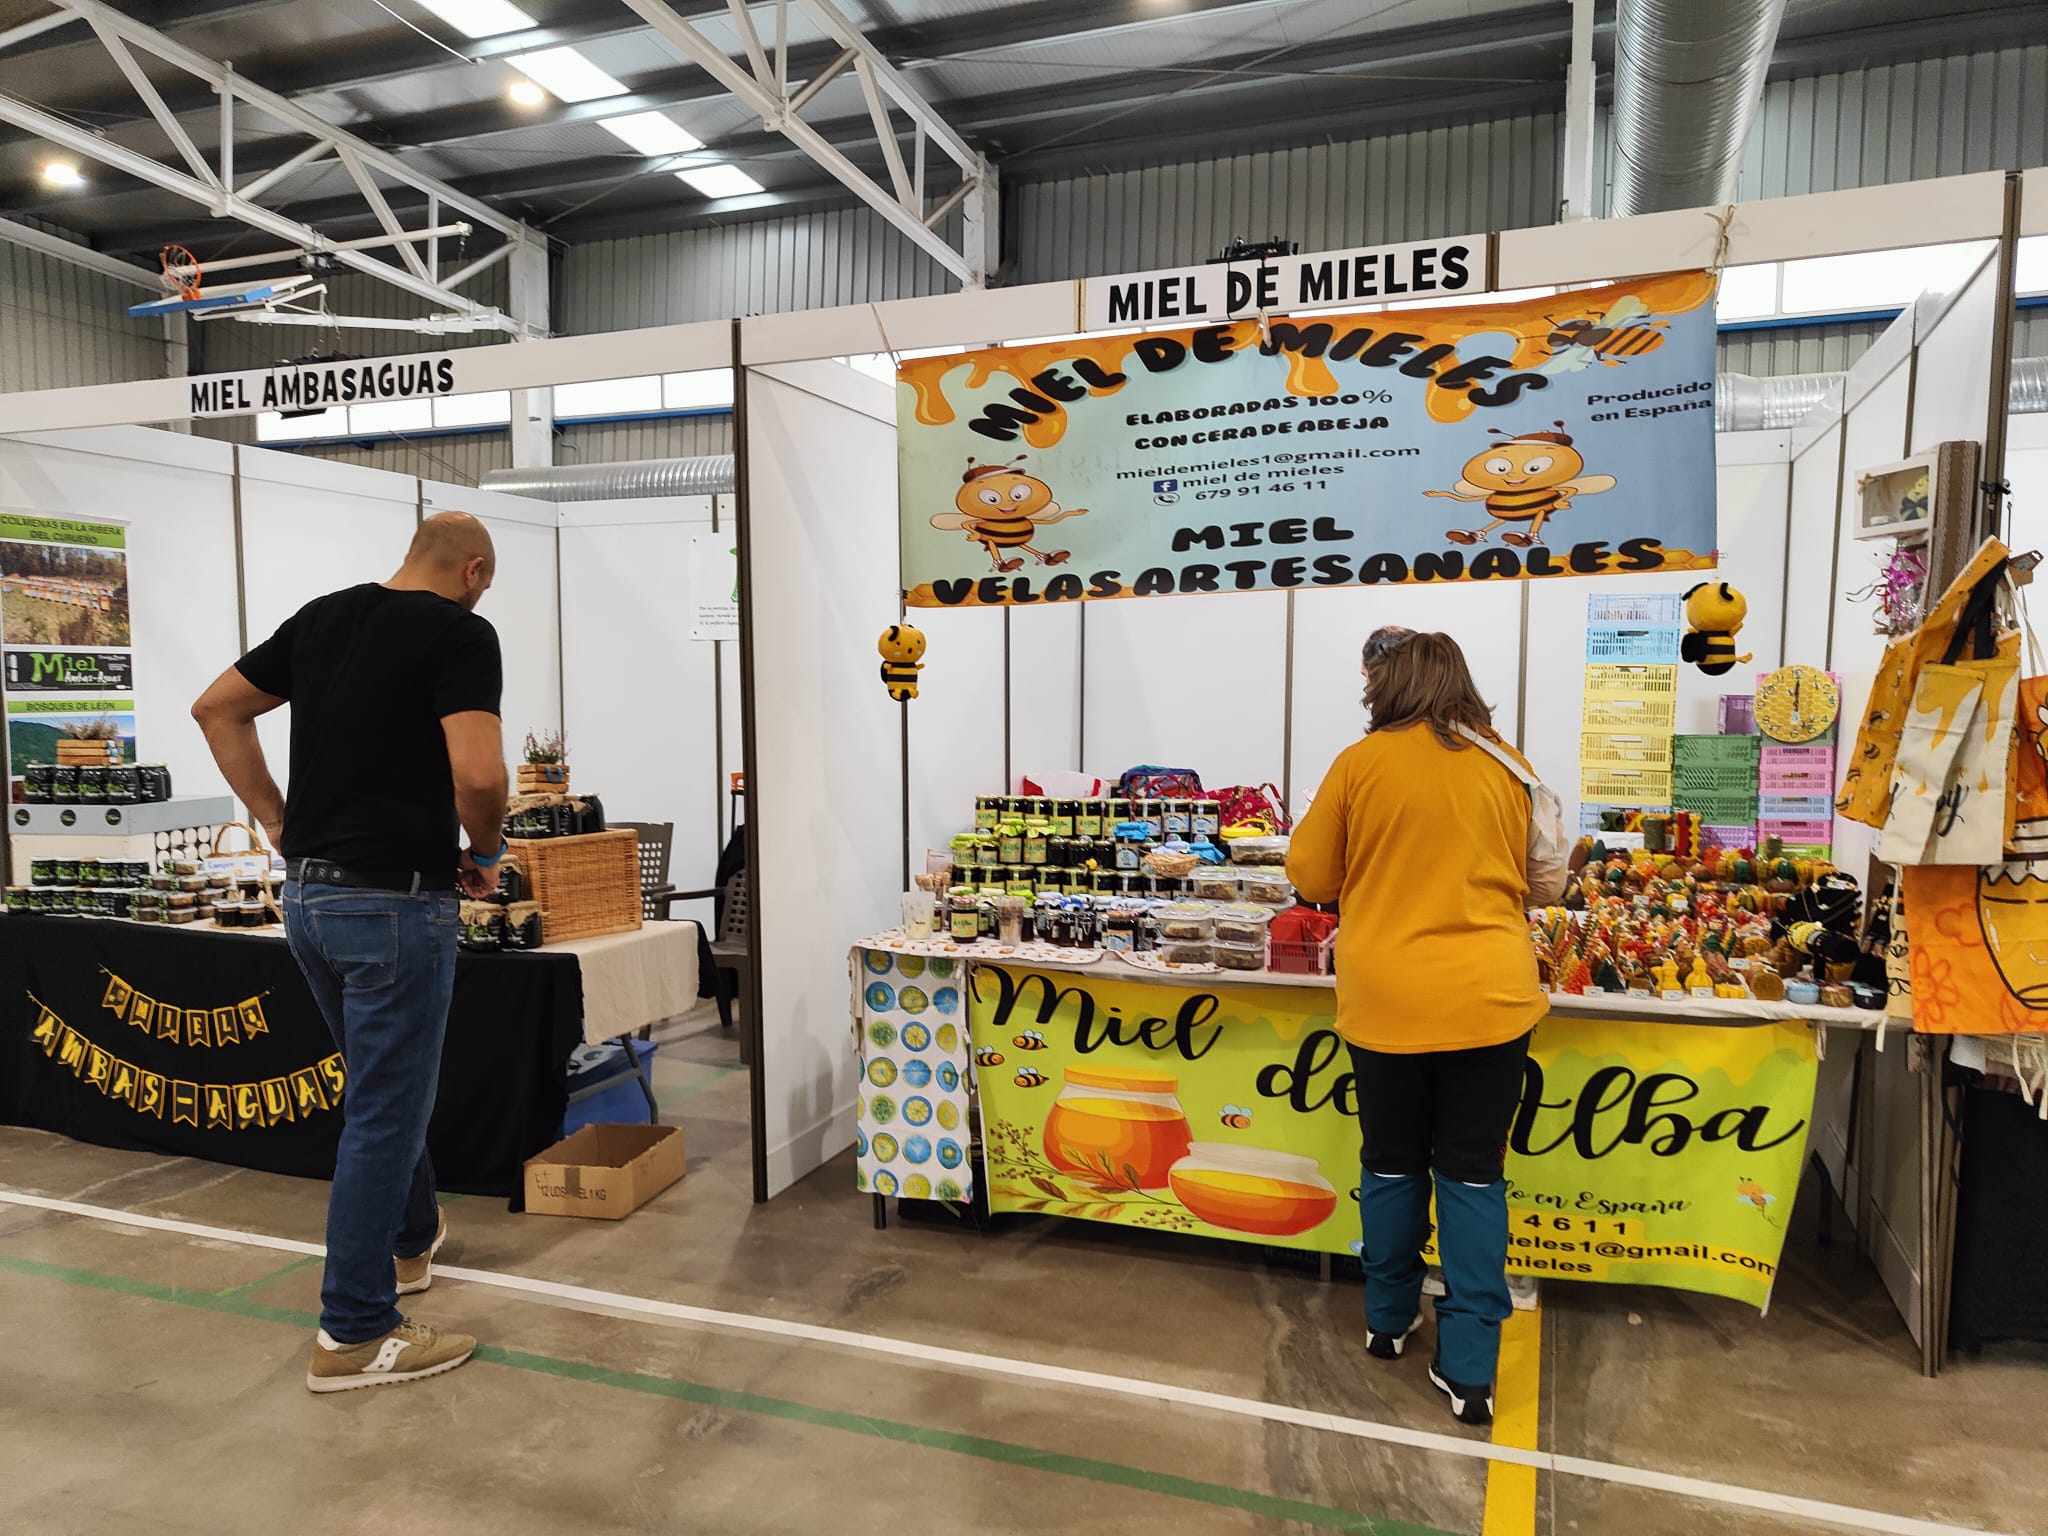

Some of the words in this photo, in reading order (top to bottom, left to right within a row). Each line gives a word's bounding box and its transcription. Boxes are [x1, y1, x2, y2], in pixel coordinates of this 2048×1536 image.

[1108, 276, 1207, 324] MIEL
[1227, 266, 1280, 314] DE
[1299, 245, 1472, 303] MIELES
[191, 379, 251, 413] MIEL
[262, 358, 455, 408] AMBASAGUAS
[968, 358, 1128, 441] MIEL
[1133, 325, 1236, 373] DE
[1259, 322, 1549, 407] MIELES
[1587, 381, 1713, 406] Producido
[1126, 396, 1299, 426] ELABORADAS
[1306, 388, 1394, 407] 100%
[1590, 410, 1620, 422] en
[1134, 434, 1188, 451] CON
[1191, 427, 1258, 445] CERA
[1261, 421, 1293, 436] DE
[1297, 416, 1391, 433] ABEJA
[1115, 445, 1421, 481] mieldemieles1@gmail.com
[1182, 474, 1228, 489] miel
[1233, 469, 1262, 484] de
[1267, 463, 1346, 480] mieles
[1194, 488, 1232, 502] 679
[1238, 485, 1261, 498] 91
[1268, 482, 1297, 495] 46
[1303, 480, 1328, 492] 11
[1172, 516, 1355, 553] MIEL
[932, 569, 1124, 606] VELAS
[1132, 537, 1666, 598] ARTESANALES
[28, 652, 100, 683] Miel
[135, 999, 232, 1036] MIEL
[969, 963, 1225, 1061] Miel
[32, 1015, 346, 1121] AMBAS-AGUAS
[1255, 1029, 1359, 1117] de
[1507, 1233, 1776, 1275] ieles1@gmail.com
